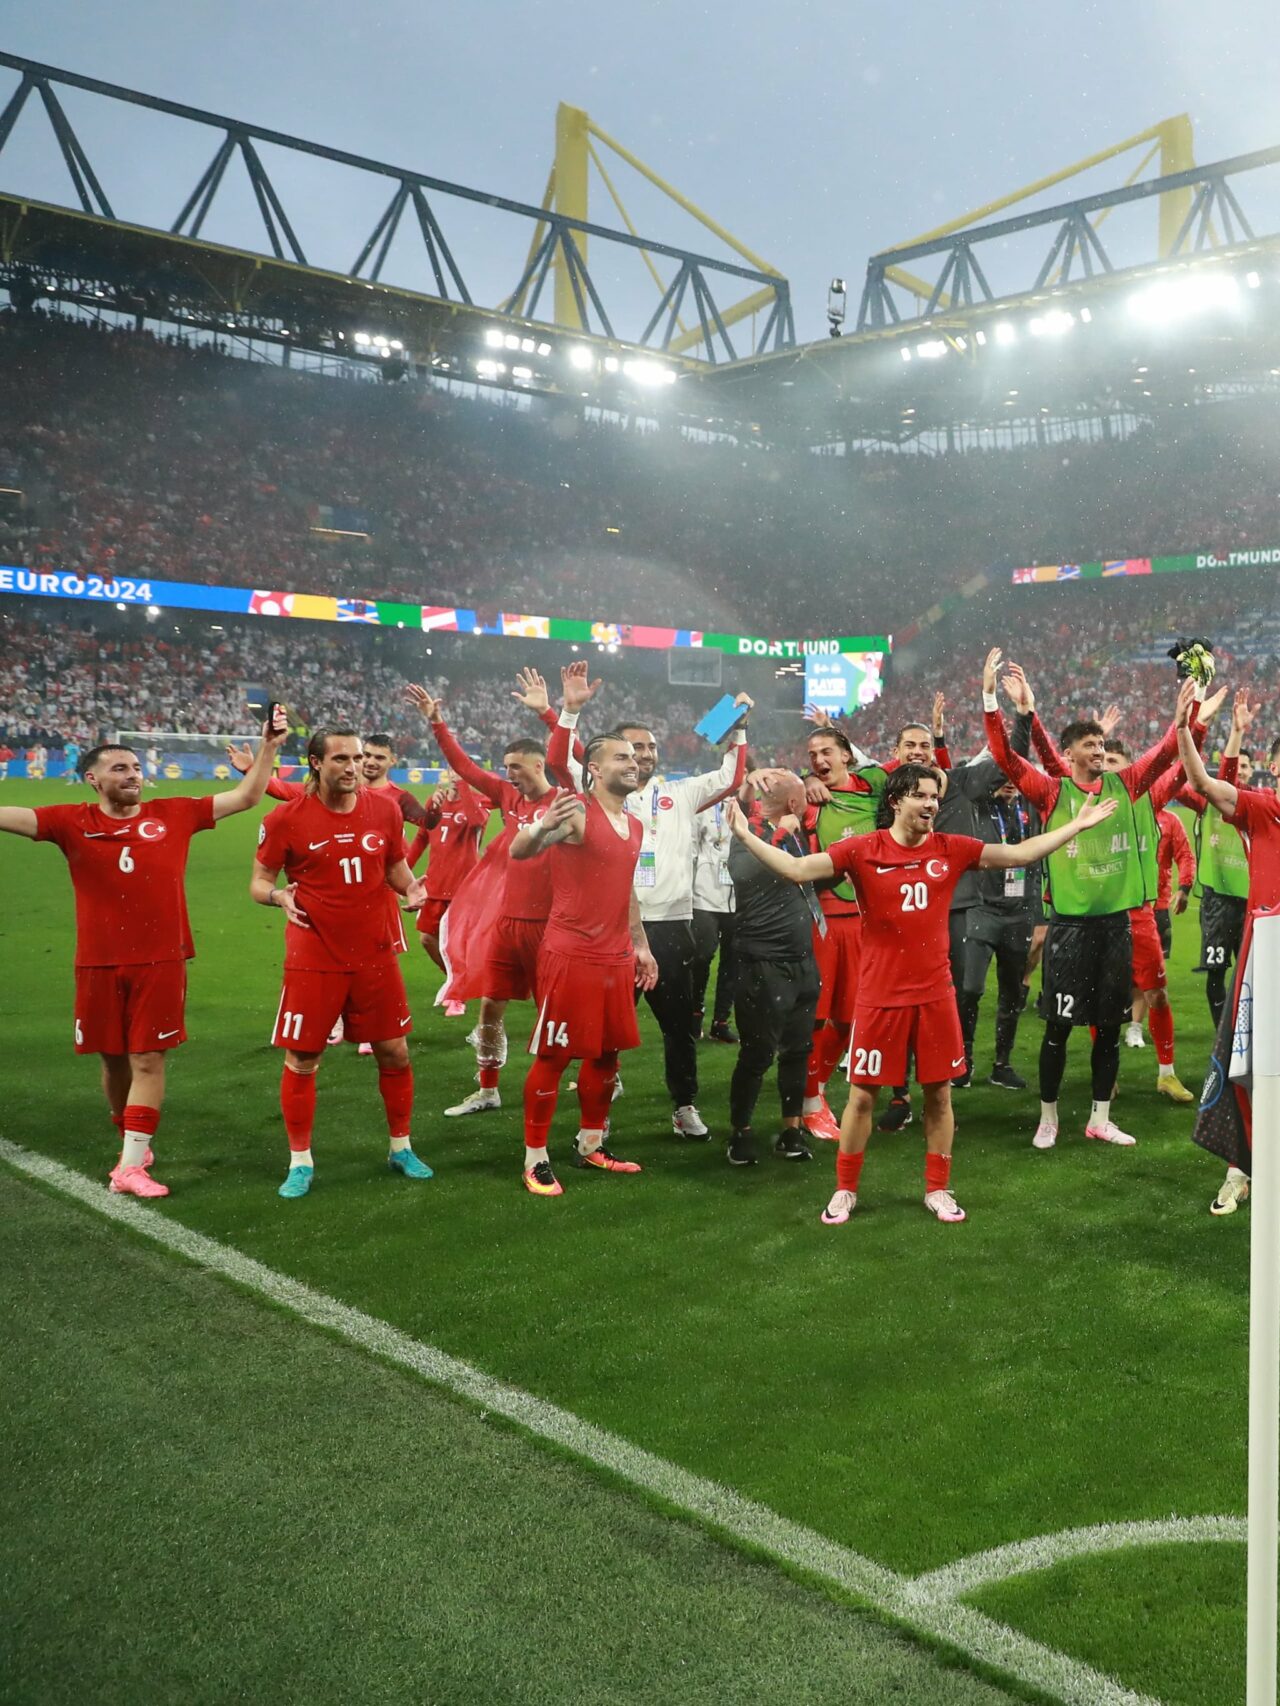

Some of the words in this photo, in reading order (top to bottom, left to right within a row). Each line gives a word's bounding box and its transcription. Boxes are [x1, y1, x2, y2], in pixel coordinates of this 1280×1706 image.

[441, 826, 448, 842] 7
[119, 846, 134, 873] 6
[339, 857, 362, 884] 11
[900, 882, 927, 912] 20
[1206, 946, 1225, 964] 23
[1056, 993, 1075, 1018] 12
[75, 1019, 83, 1045] 6
[282, 1011, 303, 1040] 11
[547, 1020, 569, 1047] 14
[854, 1047, 882, 1077] 20
